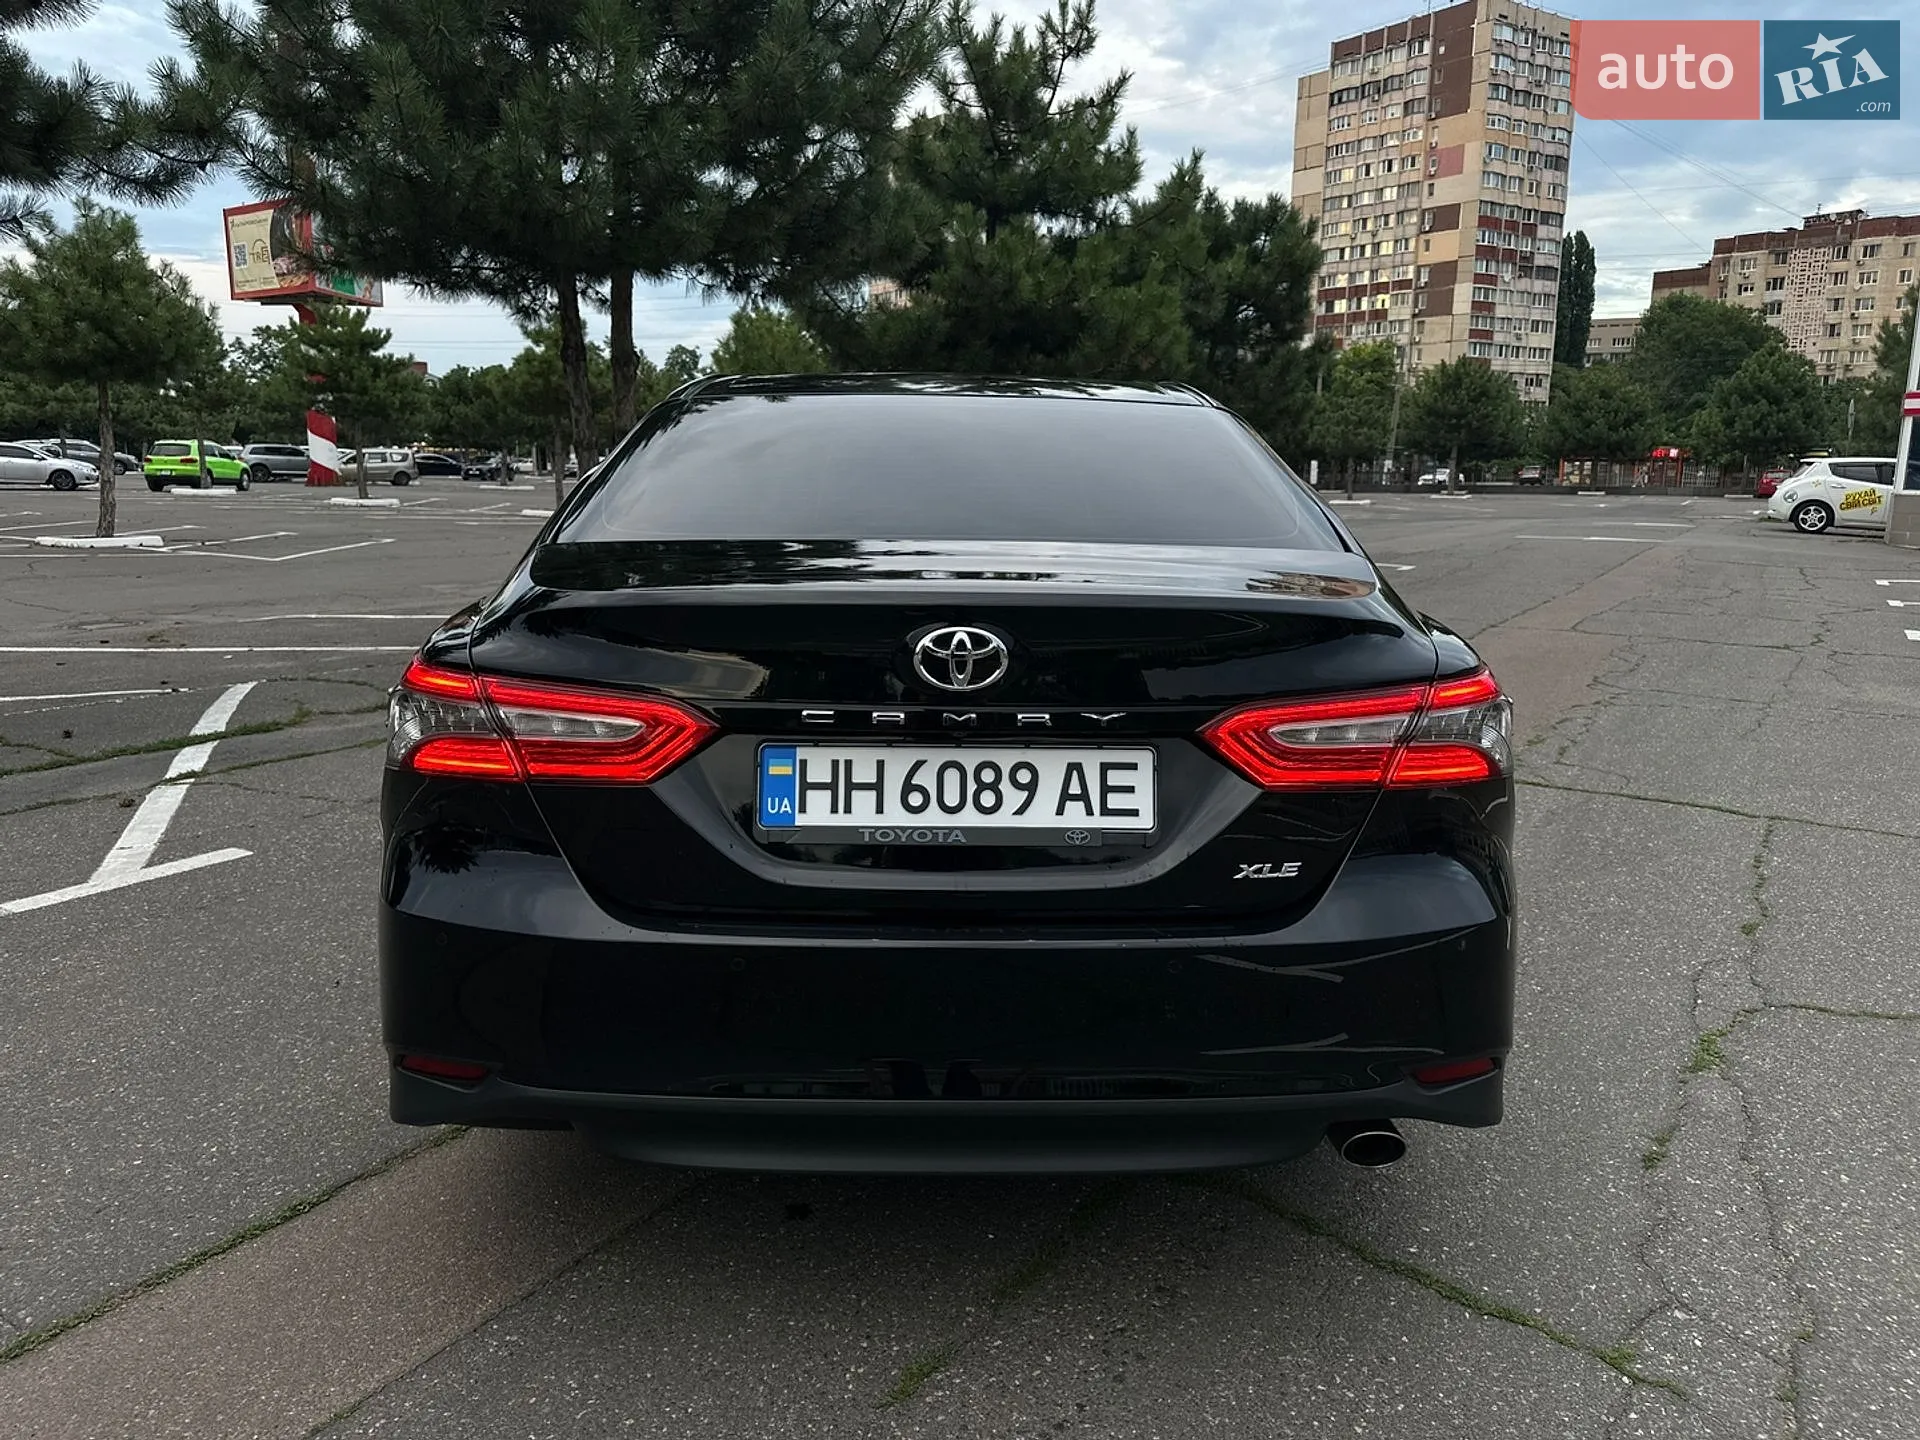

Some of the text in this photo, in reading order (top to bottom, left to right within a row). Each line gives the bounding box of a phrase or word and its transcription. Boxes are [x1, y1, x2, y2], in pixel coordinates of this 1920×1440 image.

[1845, 488, 1876, 501] РУХАЙ
[801, 710, 1127, 727] CAMRY
[767, 758, 1140, 818] UA HH 6089 AE
[858, 828, 967, 844] TOYOTA
[1232, 861, 1303, 879] XLE
